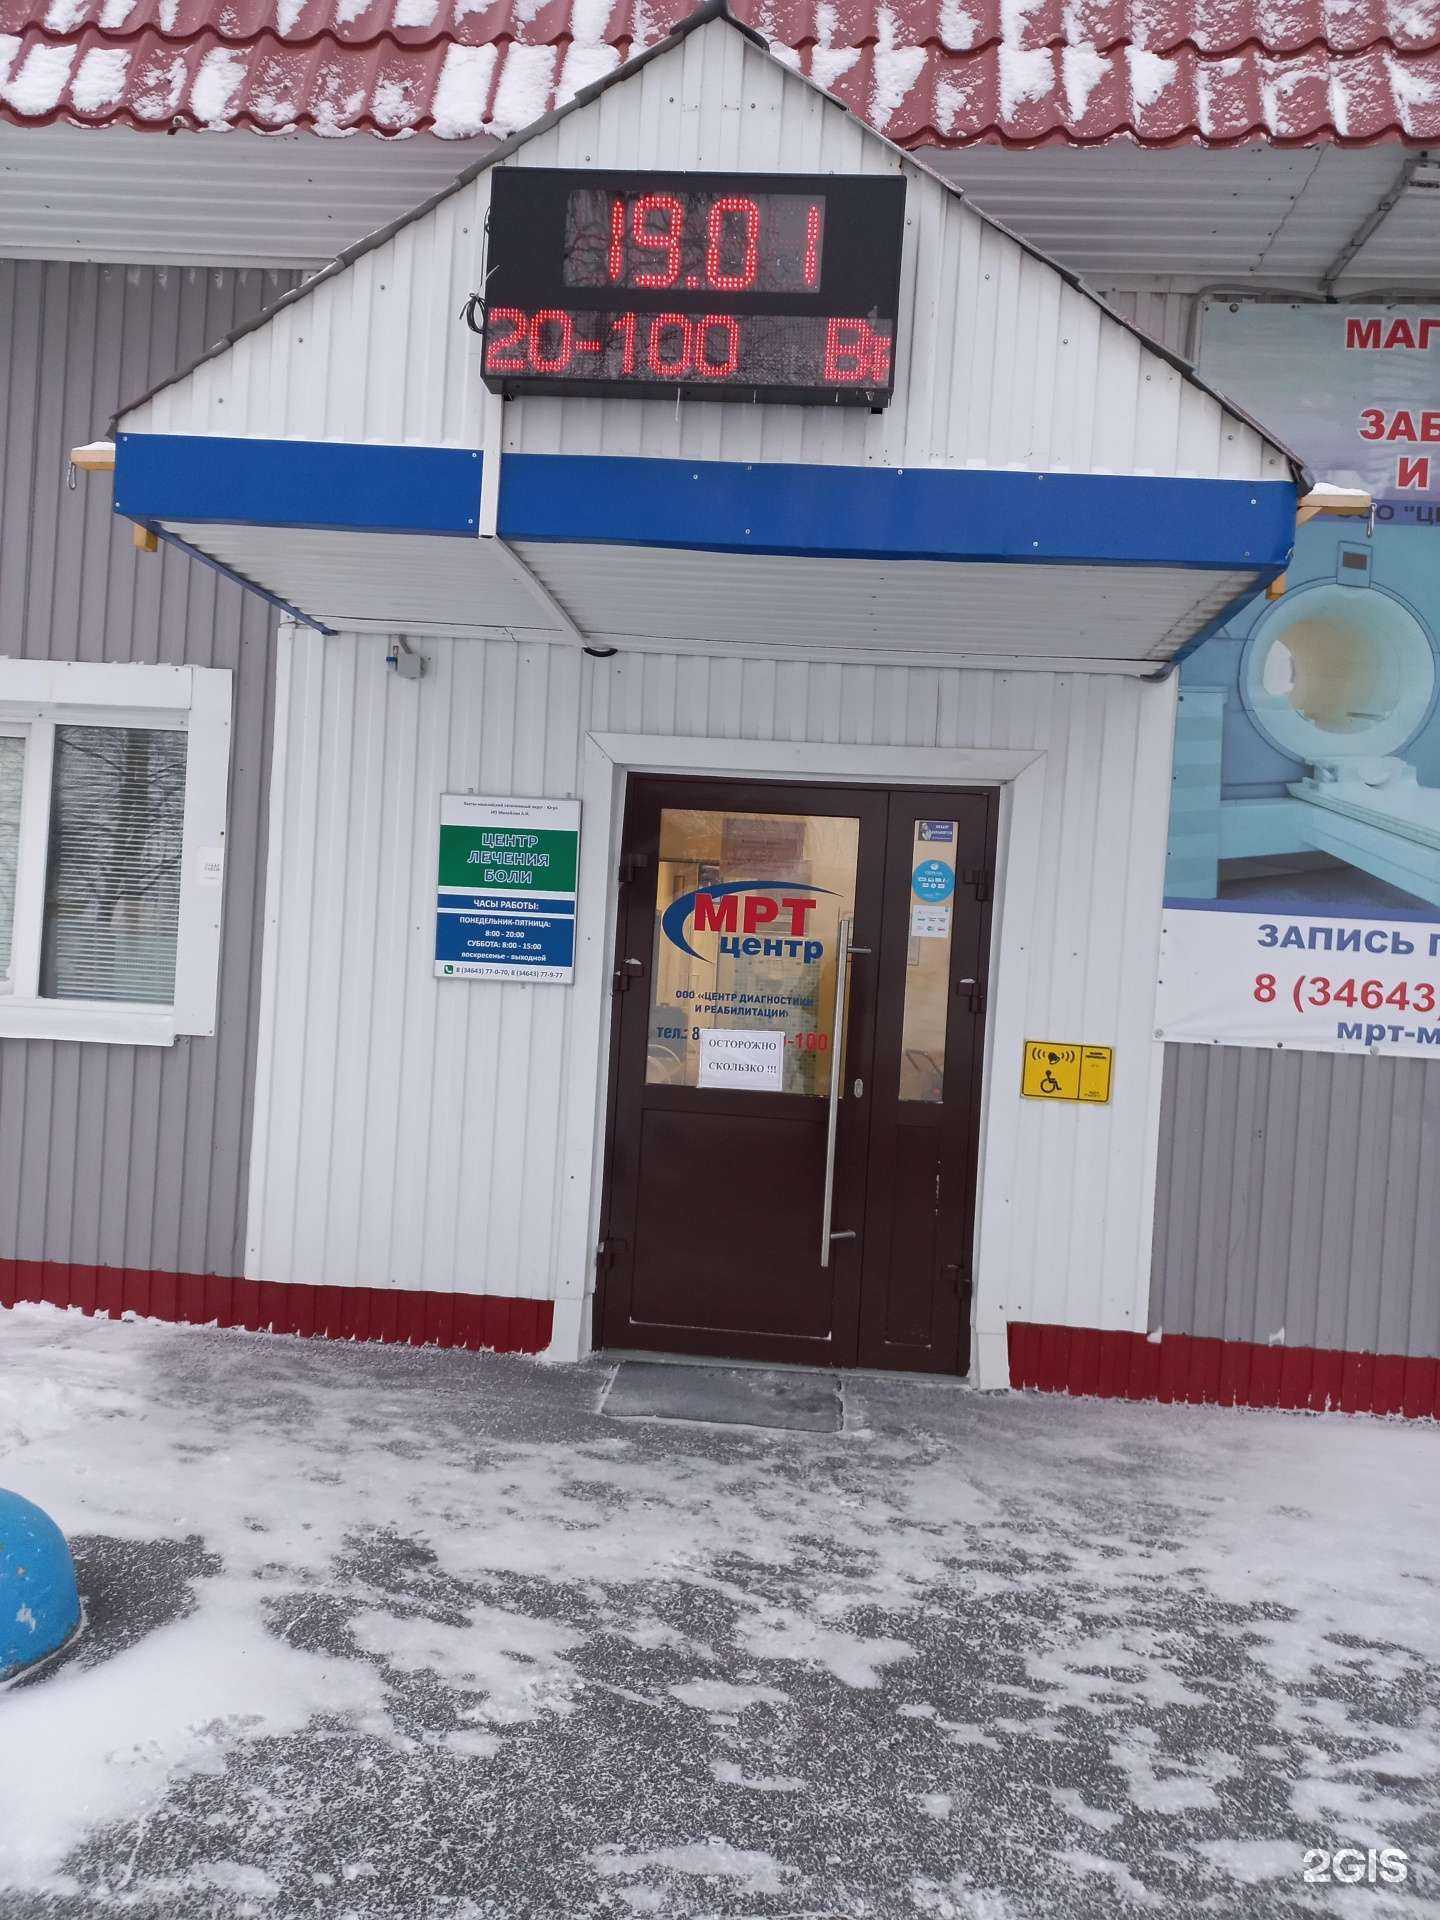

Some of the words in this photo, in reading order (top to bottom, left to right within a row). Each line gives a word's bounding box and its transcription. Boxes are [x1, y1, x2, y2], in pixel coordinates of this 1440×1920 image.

[486, 307, 740, 378] 20-100
[1347, 318, 1440, 350] МАГ
[1397, 457, 1430, 488] И
[481, 832, 539, 849] ЦЕНТР
[466, 850, 550, 867] ЛЕЧЕНИЯ
[483, 868, 532, 884] БОЛИ
[473, 899, 499, 908] ЧАСЫ
[500, 901, 540, 910] РАБОТЫ:
[694, 893, 816, 937] МРТ
[467, 940, 501, 949] СУББОТА:
[1257, 923, 1415, 955] ЗАПИСЬ
[720, 936, 823, 964] центр
[676, 990, 695, 1000] ООО
[697, 991, 738, 1002] «ЦЕНТР
[1253, 973, 1276, 1003] 8
[1293, 975, 1440, 1022] (34643
[695, 1005, 702, 1013] И
[708, 1039, 777, 1051] ОСТОРОЖНО
[708, 1061, 765, 1073] СКОЛЬЗКО
